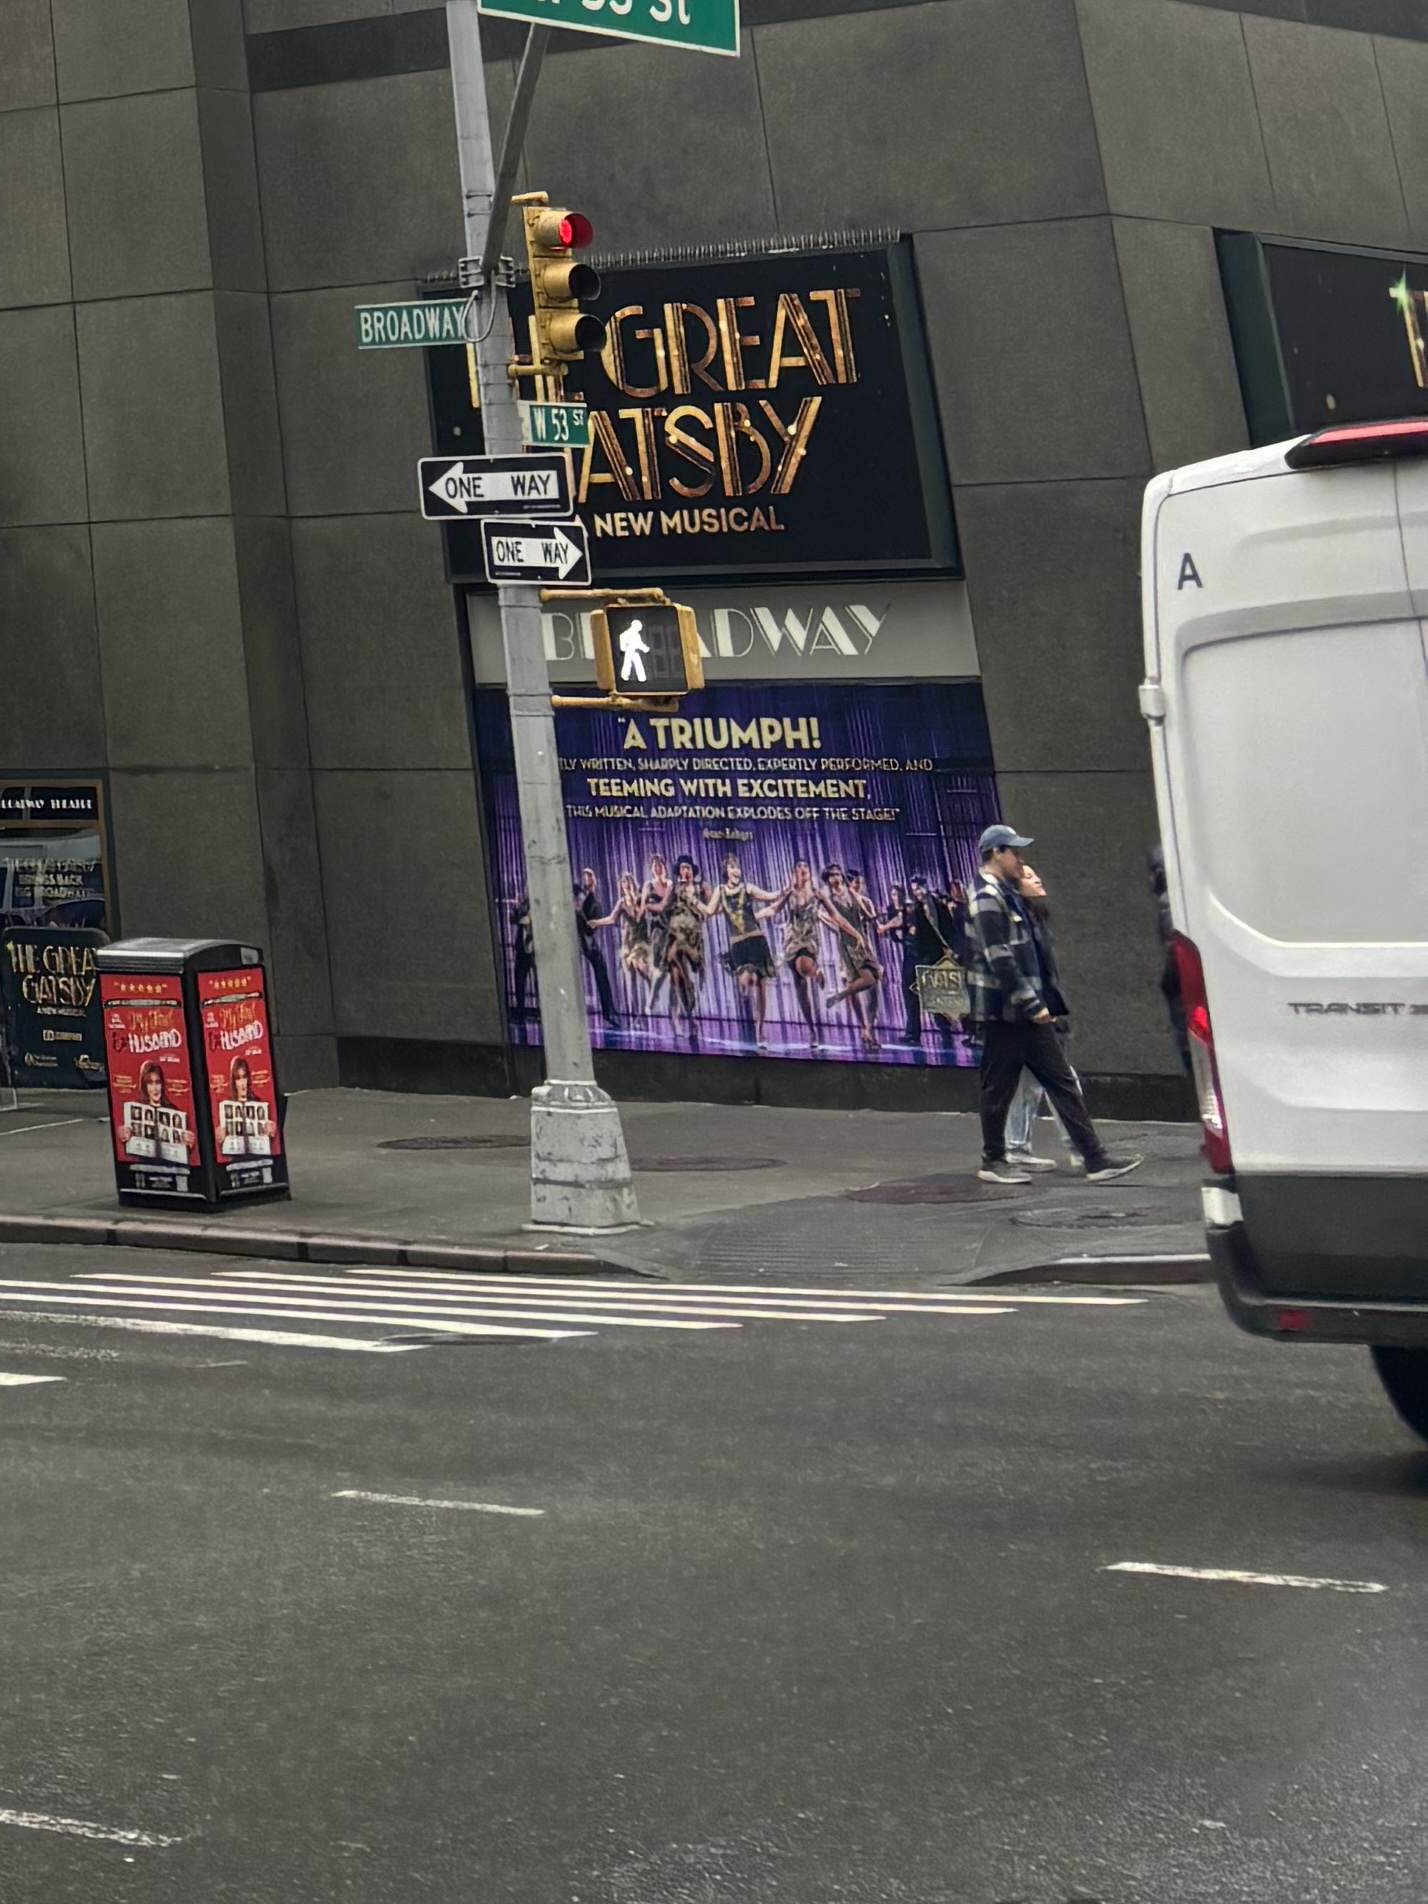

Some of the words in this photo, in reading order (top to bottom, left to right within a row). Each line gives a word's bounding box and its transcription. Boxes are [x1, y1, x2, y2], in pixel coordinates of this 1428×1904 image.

[360, 306, 465, 343] BROADWAY
[601, 288, 861, 398] GREAT
[533, 407, 545, 440] W
[551, 408, 569, 441] 53
[573, 409, 584, 426] ST
[578, 396, 822, 504] ATSBY
[445, 476, 484, 498] ONE
[510, 474, 551, 496] WAY
[594, 511, 654, 538] NEW
[660, 506, 785, 535] MUSICAL
[496, 541, 524, 563] ONE
[542, 543, 569, 564] WAY
[1176, 552, 1203, 590] A
[649, 717, 821, 749] TRIUMPH!
[580, 758, 636, 771] WRITTEN,
[638, 758, 689, 770] SHARPLY
[757, 758, 817, 770] EXPERTLY
[906, 759, 933, 770] AND
[587, 778, 675, 797] TEEMING
[679, 778, 732, 797] WITH
[737, 779, 871, 799] EXCITEMENT,
[566, 804, 592, 817] THIS
[595, 805, 648, 818] MUSICAL
[650, 806, 725, 818] ADAPTATION
[727, 806, 792, 819] EXPLODES
[795, 807, 820, 820] OFF
[823, 807, 848, 820] THE
[22, 976, 96, 1007] GATSBY
[1287, 1002, 1406, 1015] TRANSIT
